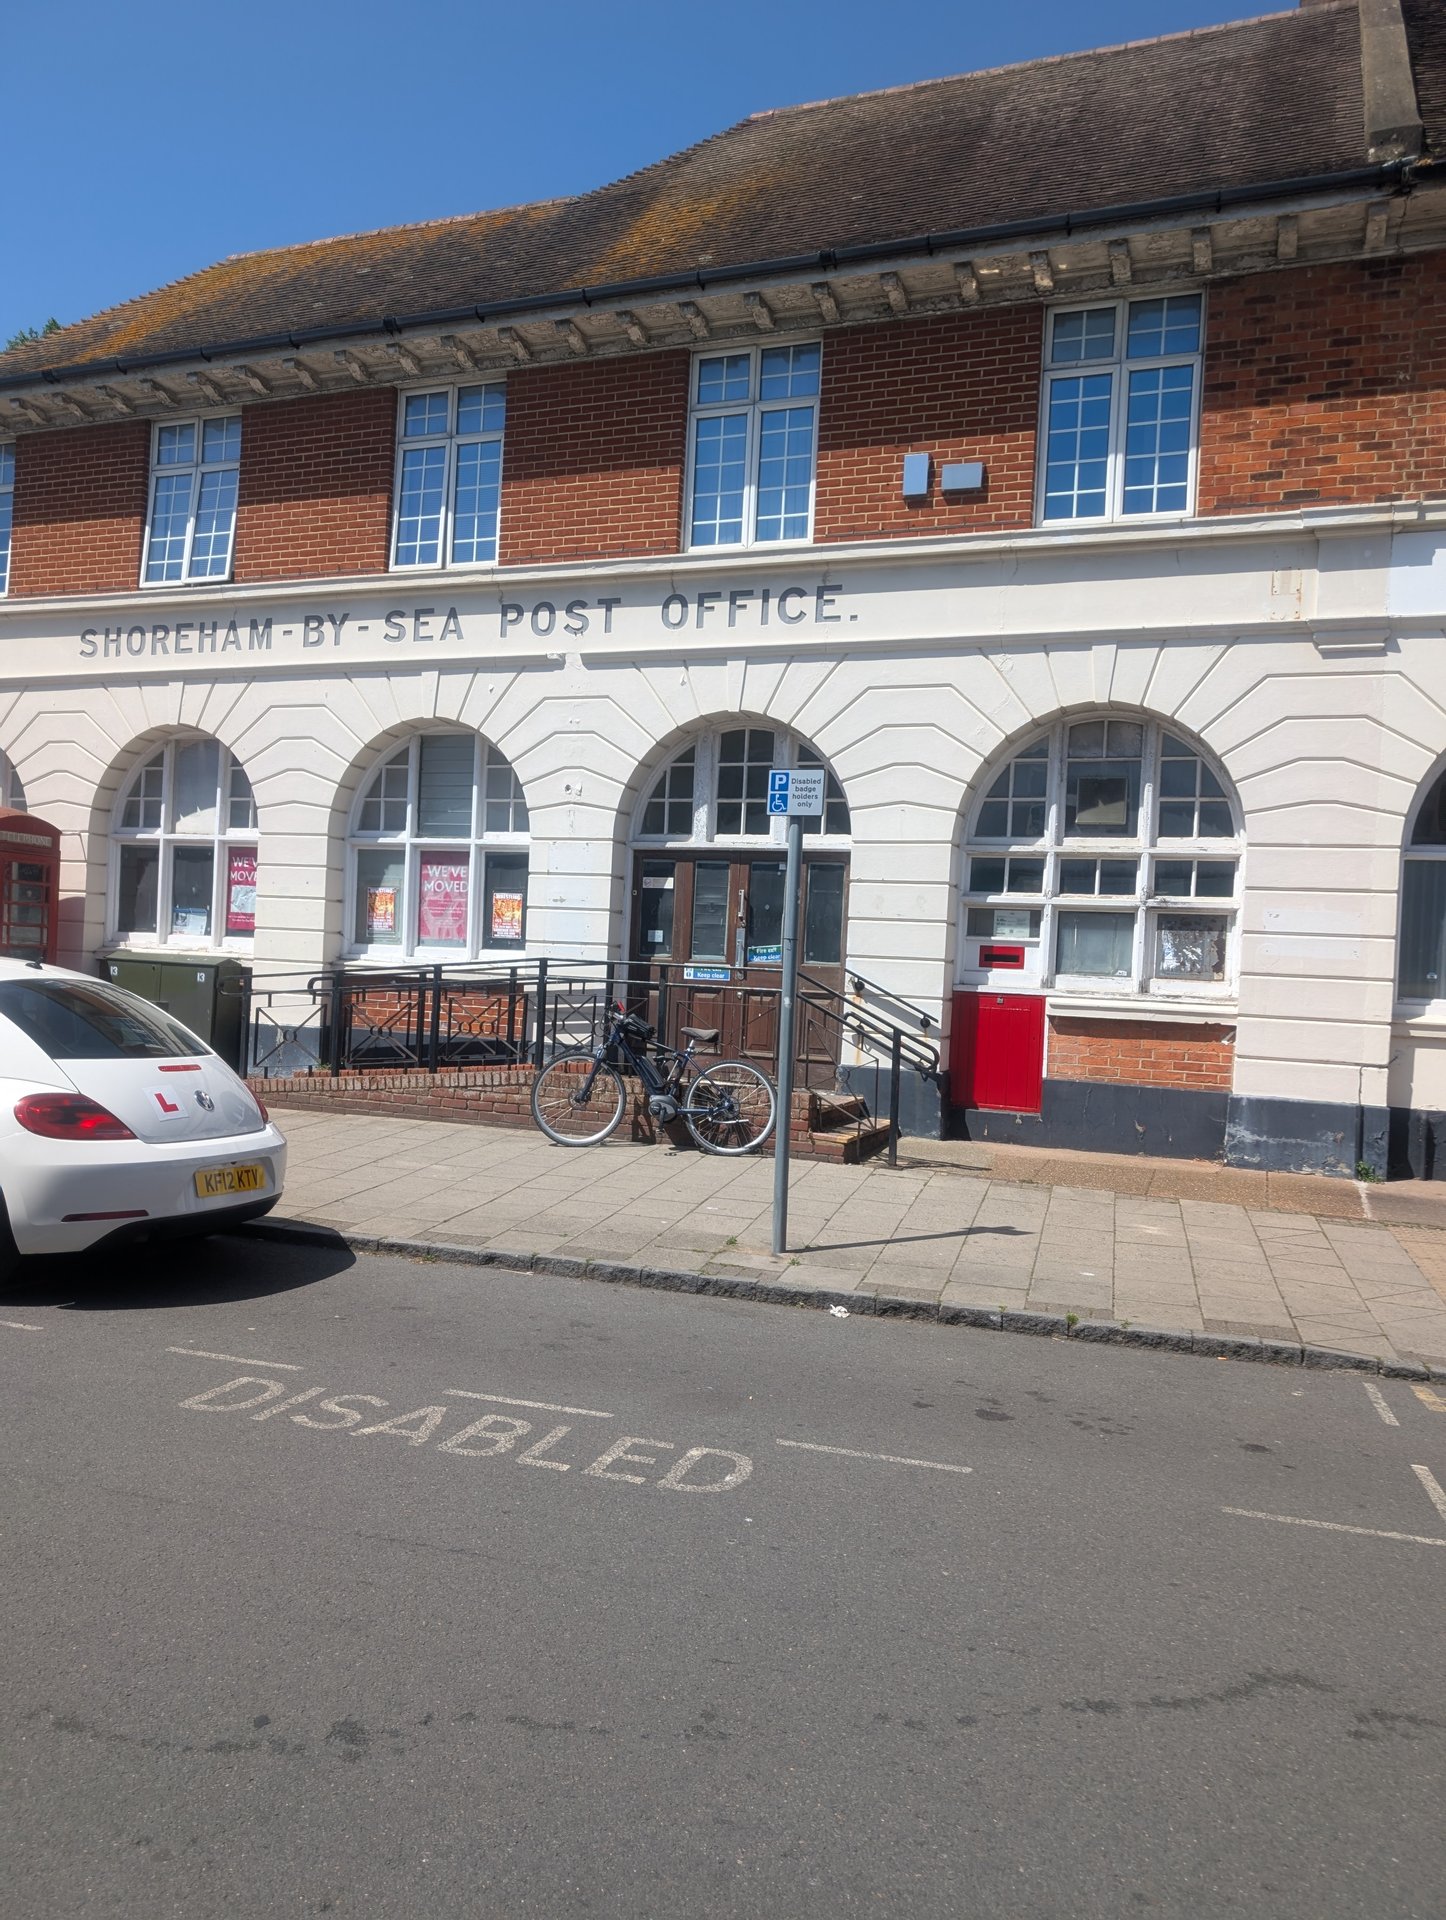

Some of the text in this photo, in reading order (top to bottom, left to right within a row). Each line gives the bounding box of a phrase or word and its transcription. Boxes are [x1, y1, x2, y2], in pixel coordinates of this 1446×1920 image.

[500, 597, 621, 638] POST
[661, 584, 859, 631] OFFICE.
[775, 774, 787, 790] P
[795, 785, 816, 793] badge
[427, 865, 468, 877] WE'VE
[424, 880, 469, 892] MOVED
[154, 1092, 179, 1113] L
[204, 1168, 258, 1193] KF12 KTV
[178, 1376, 754, 1493] DISABLED
